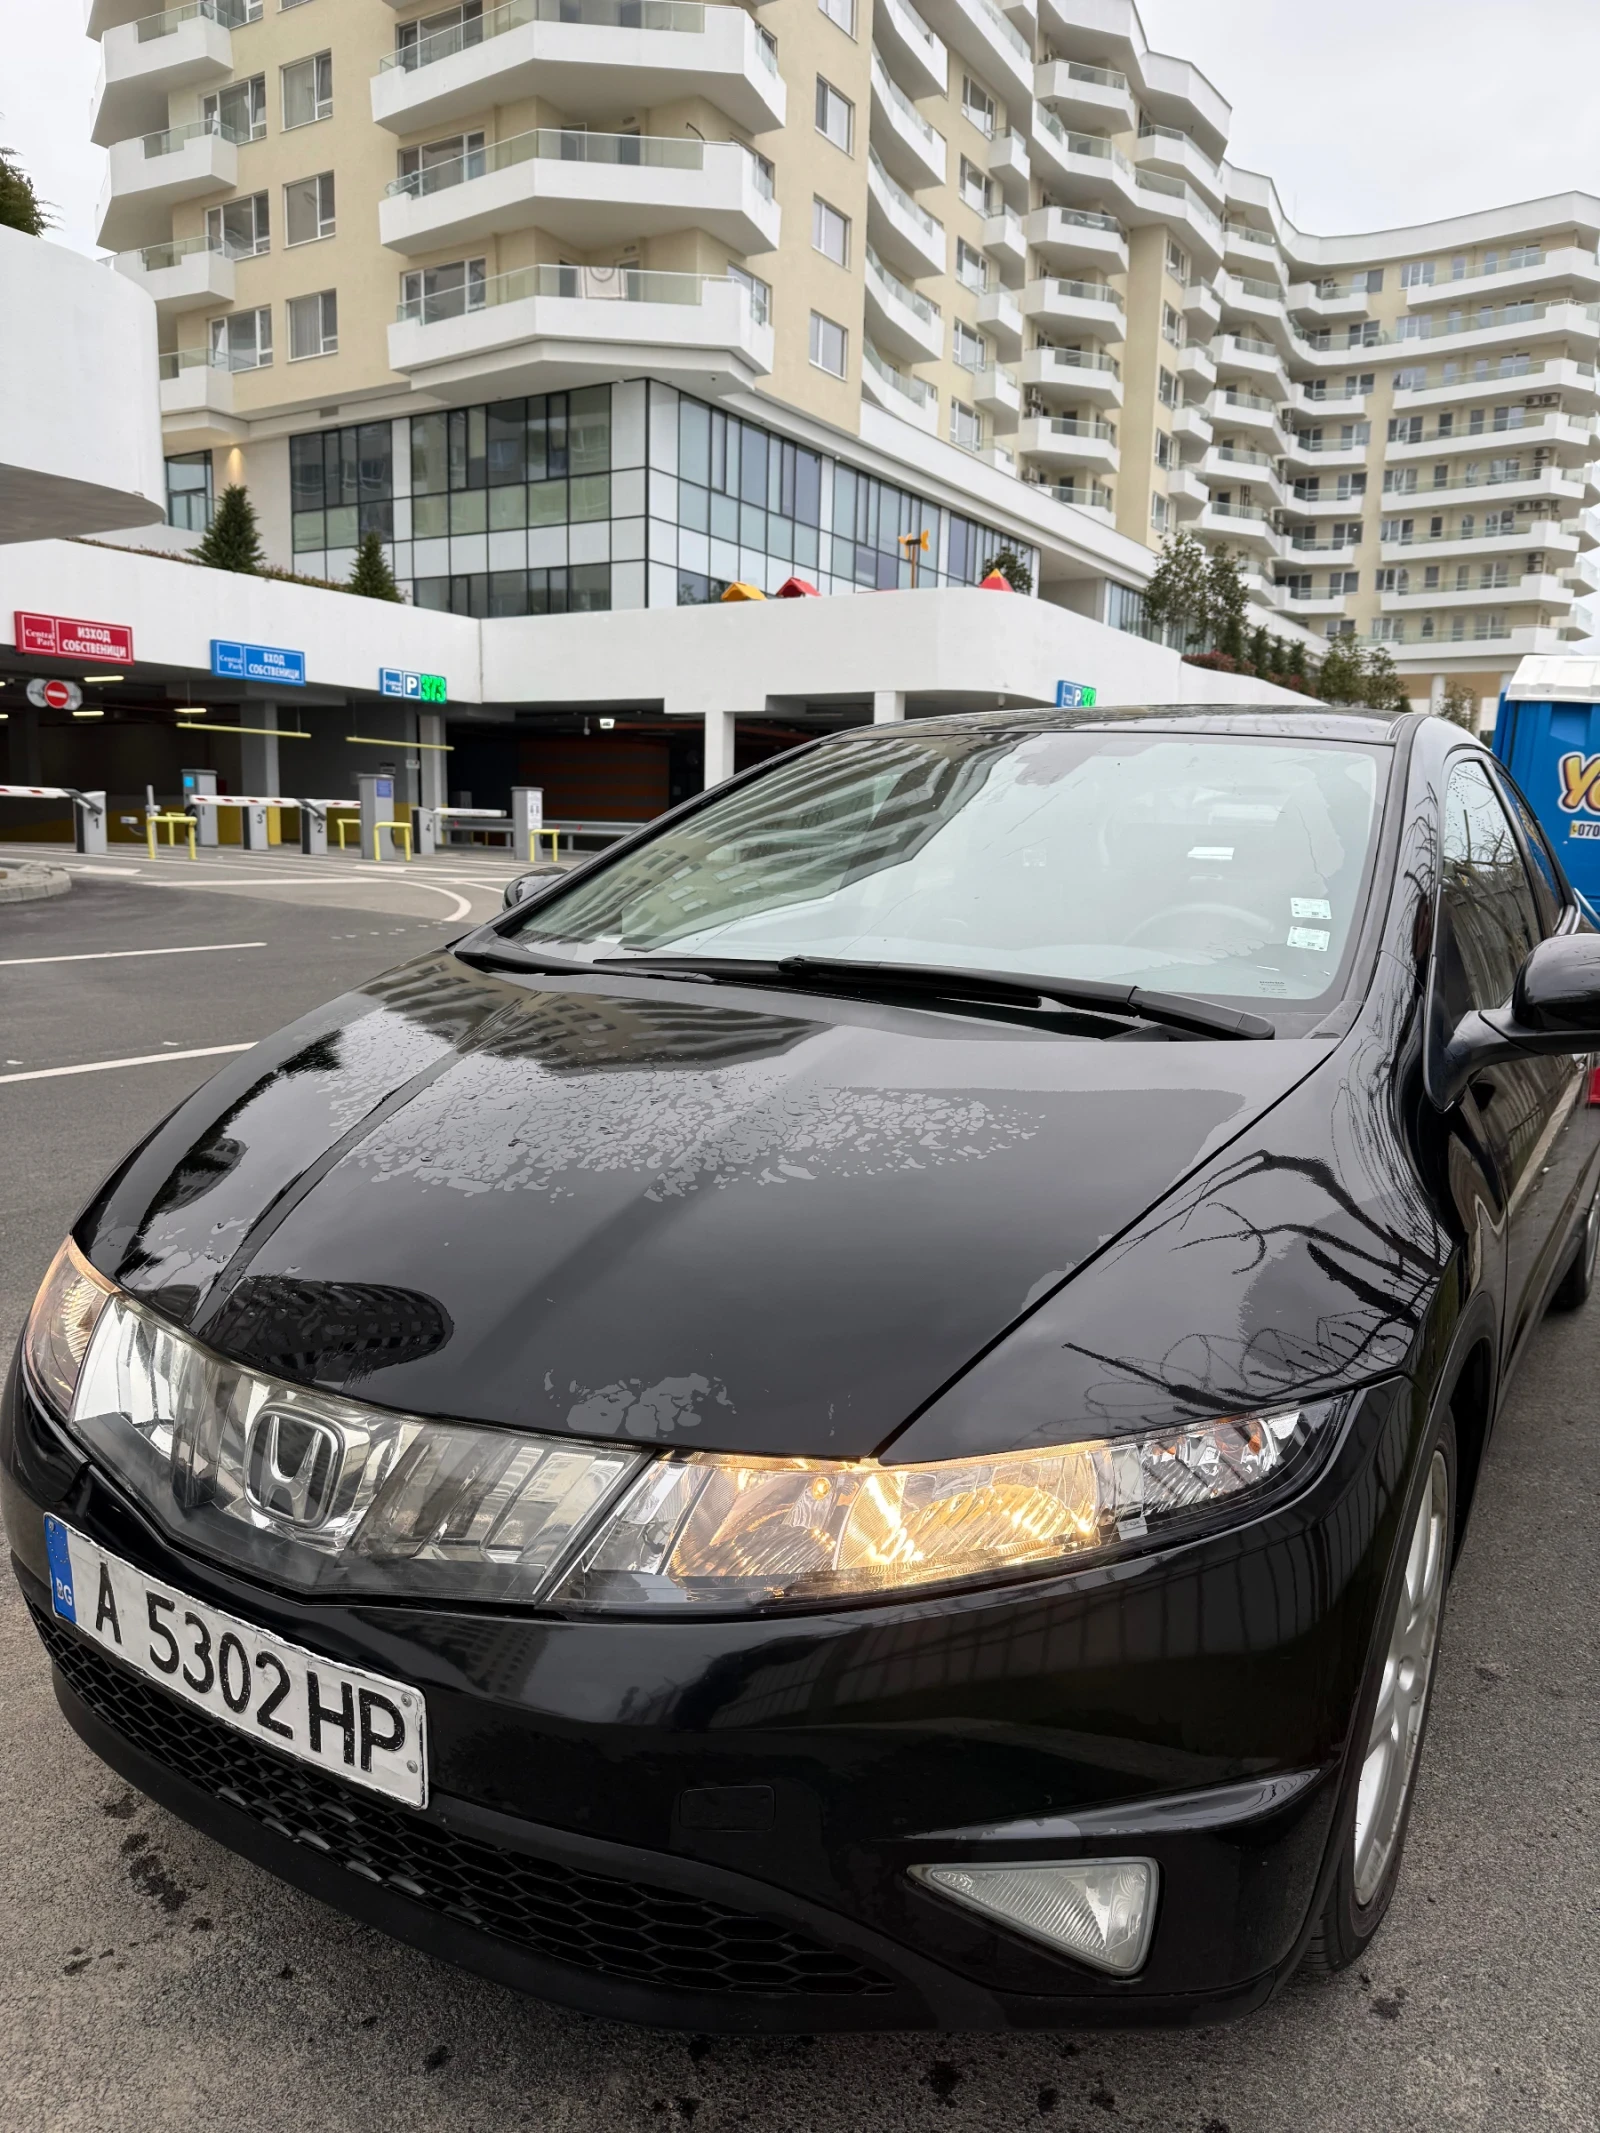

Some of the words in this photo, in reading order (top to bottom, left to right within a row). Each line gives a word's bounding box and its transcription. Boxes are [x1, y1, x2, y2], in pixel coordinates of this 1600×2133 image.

[25, 629, 55, 640] Central
[77, 627, 111, 643] ИЗХОД
[37, 638, 55, 647] Park
[62, 639, 127, 658] СОБСТВЕНИЦИ
[219, 654, 243, 664] Central
[263, 652, 285, 666] ВХОД
[248, 663, 300, 680] СОБСТВЕНИЦИ
[406, 677, 417, 694] P
[421, 675, 446, 702] 373
[1074, 689, 1081, 706] P
[92, 818, 99, 830] 1
[257, 813, 263, 825] 3
[317, 823, 323, 834] 2
[55, 1576, 74, 1608] BG
[94, 1561, 122, 1645] A
[145, 1590, 294, 1740] 5302
[307, 1671, 405, 1772] HP
